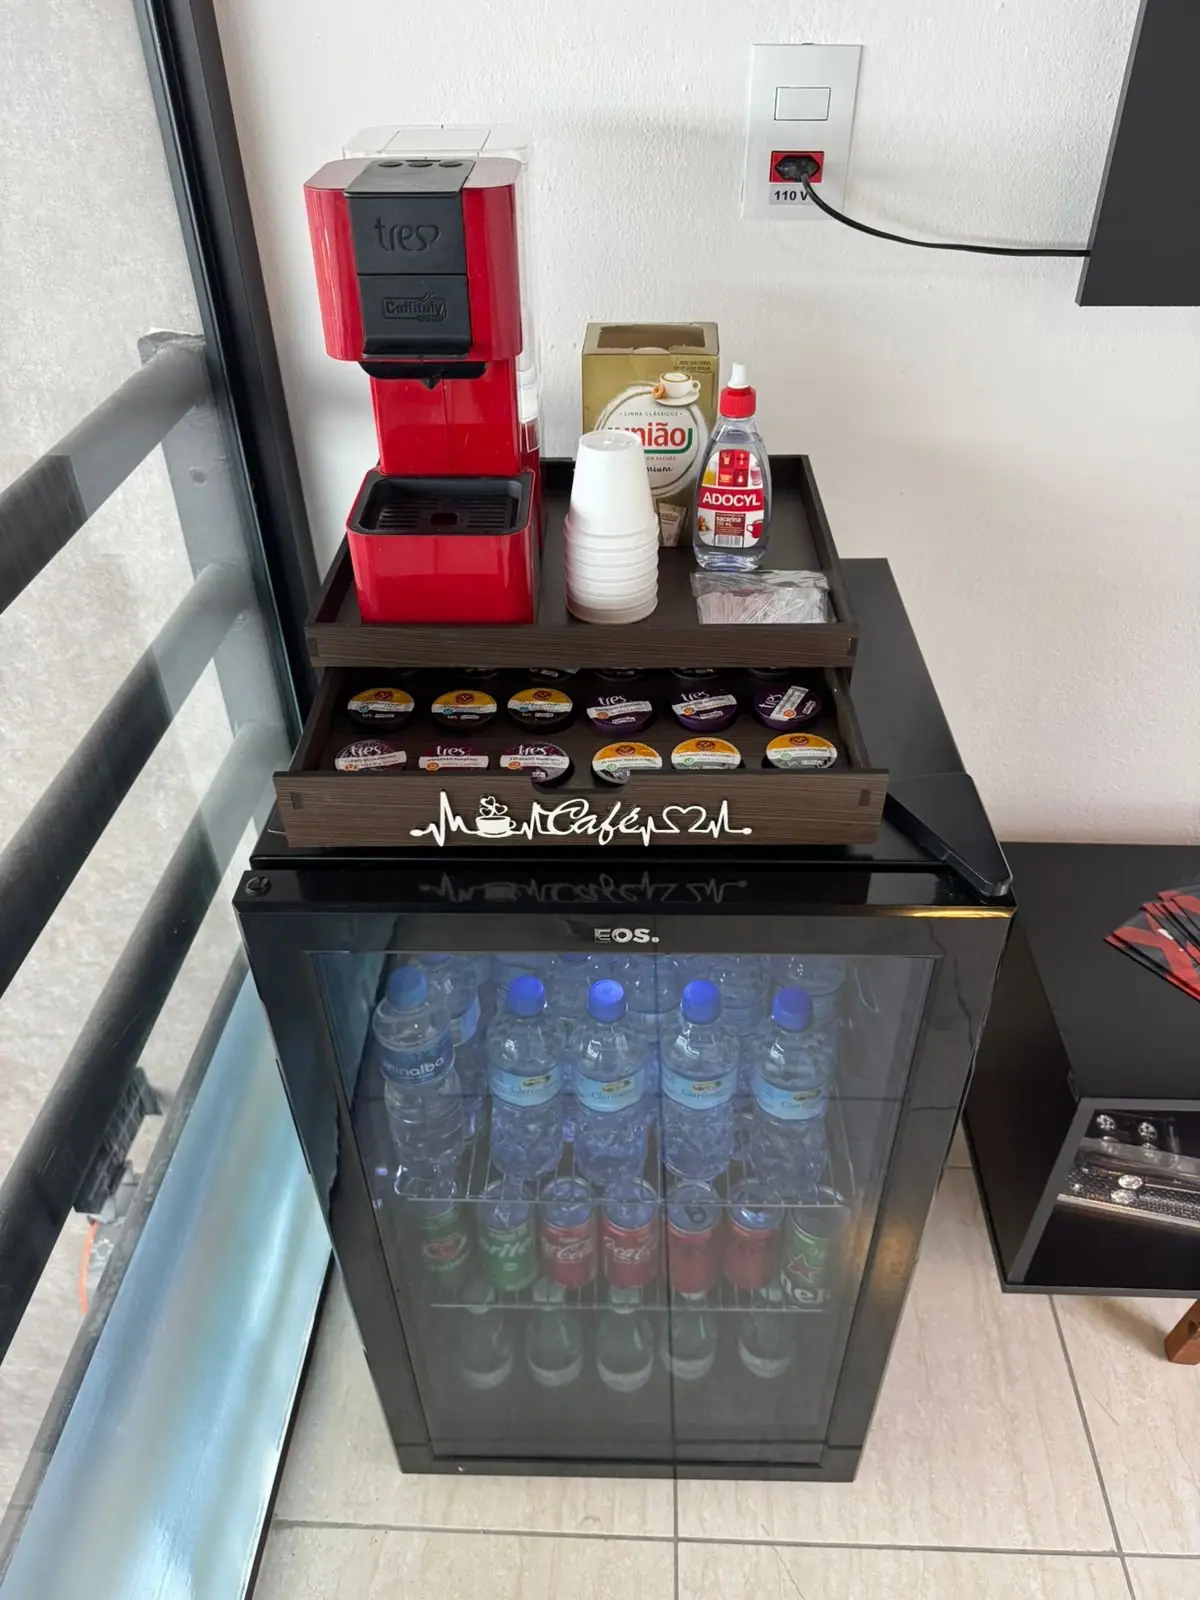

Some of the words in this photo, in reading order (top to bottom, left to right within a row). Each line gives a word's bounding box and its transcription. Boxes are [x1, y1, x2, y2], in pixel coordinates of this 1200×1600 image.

[774, 191, 797, 201] 110
[800, 191, 809, 201] V
[374, 217, 441, 251] tres
[702, 491, 761, 507] ADOCYL
[598, 695, 627, 706] tres
[351, 745, 382, 757] tres
[436, 745, 466, 756] tres
[519, 744, 547, 756] tres
[548, 798, 641, 846] Café
